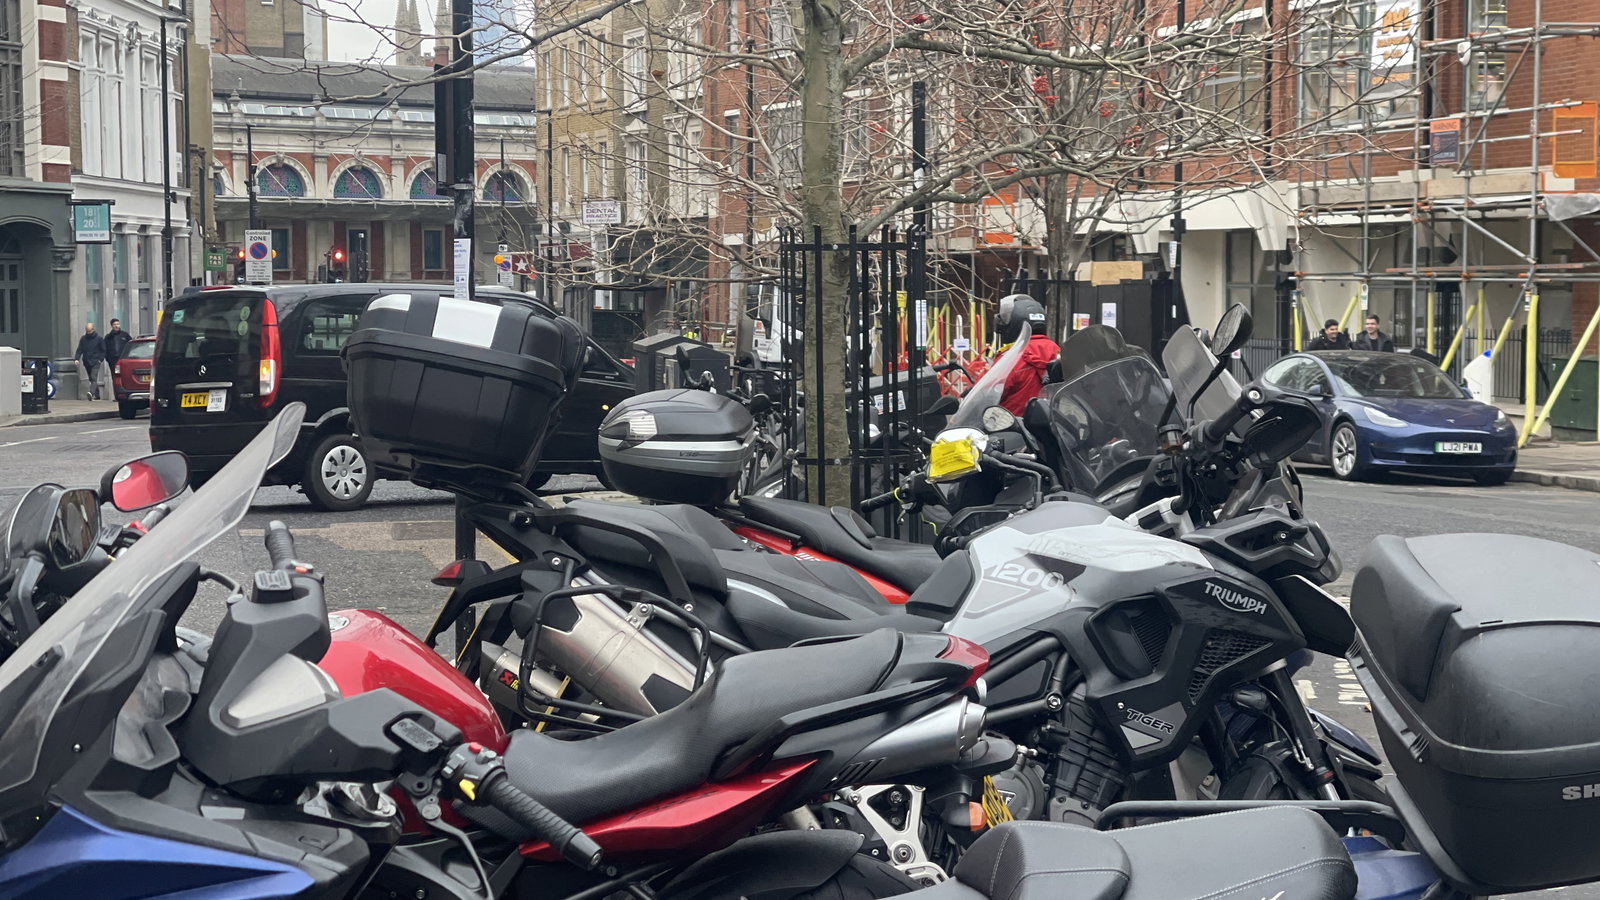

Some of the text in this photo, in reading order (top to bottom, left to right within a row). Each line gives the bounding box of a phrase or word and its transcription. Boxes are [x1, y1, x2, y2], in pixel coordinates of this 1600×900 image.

[83, 207, 94, 217] 18
[83, 220, 94, 229] 20
[184, 394, 207, 406] T4 XCY
[1442, 442, 1461, 451] LJ21
[990, 562, 1065, 590] 1200
[1205, 581, 1267, 615] TRIUMPH
[1126, 708, 1175, 734] TIGER
